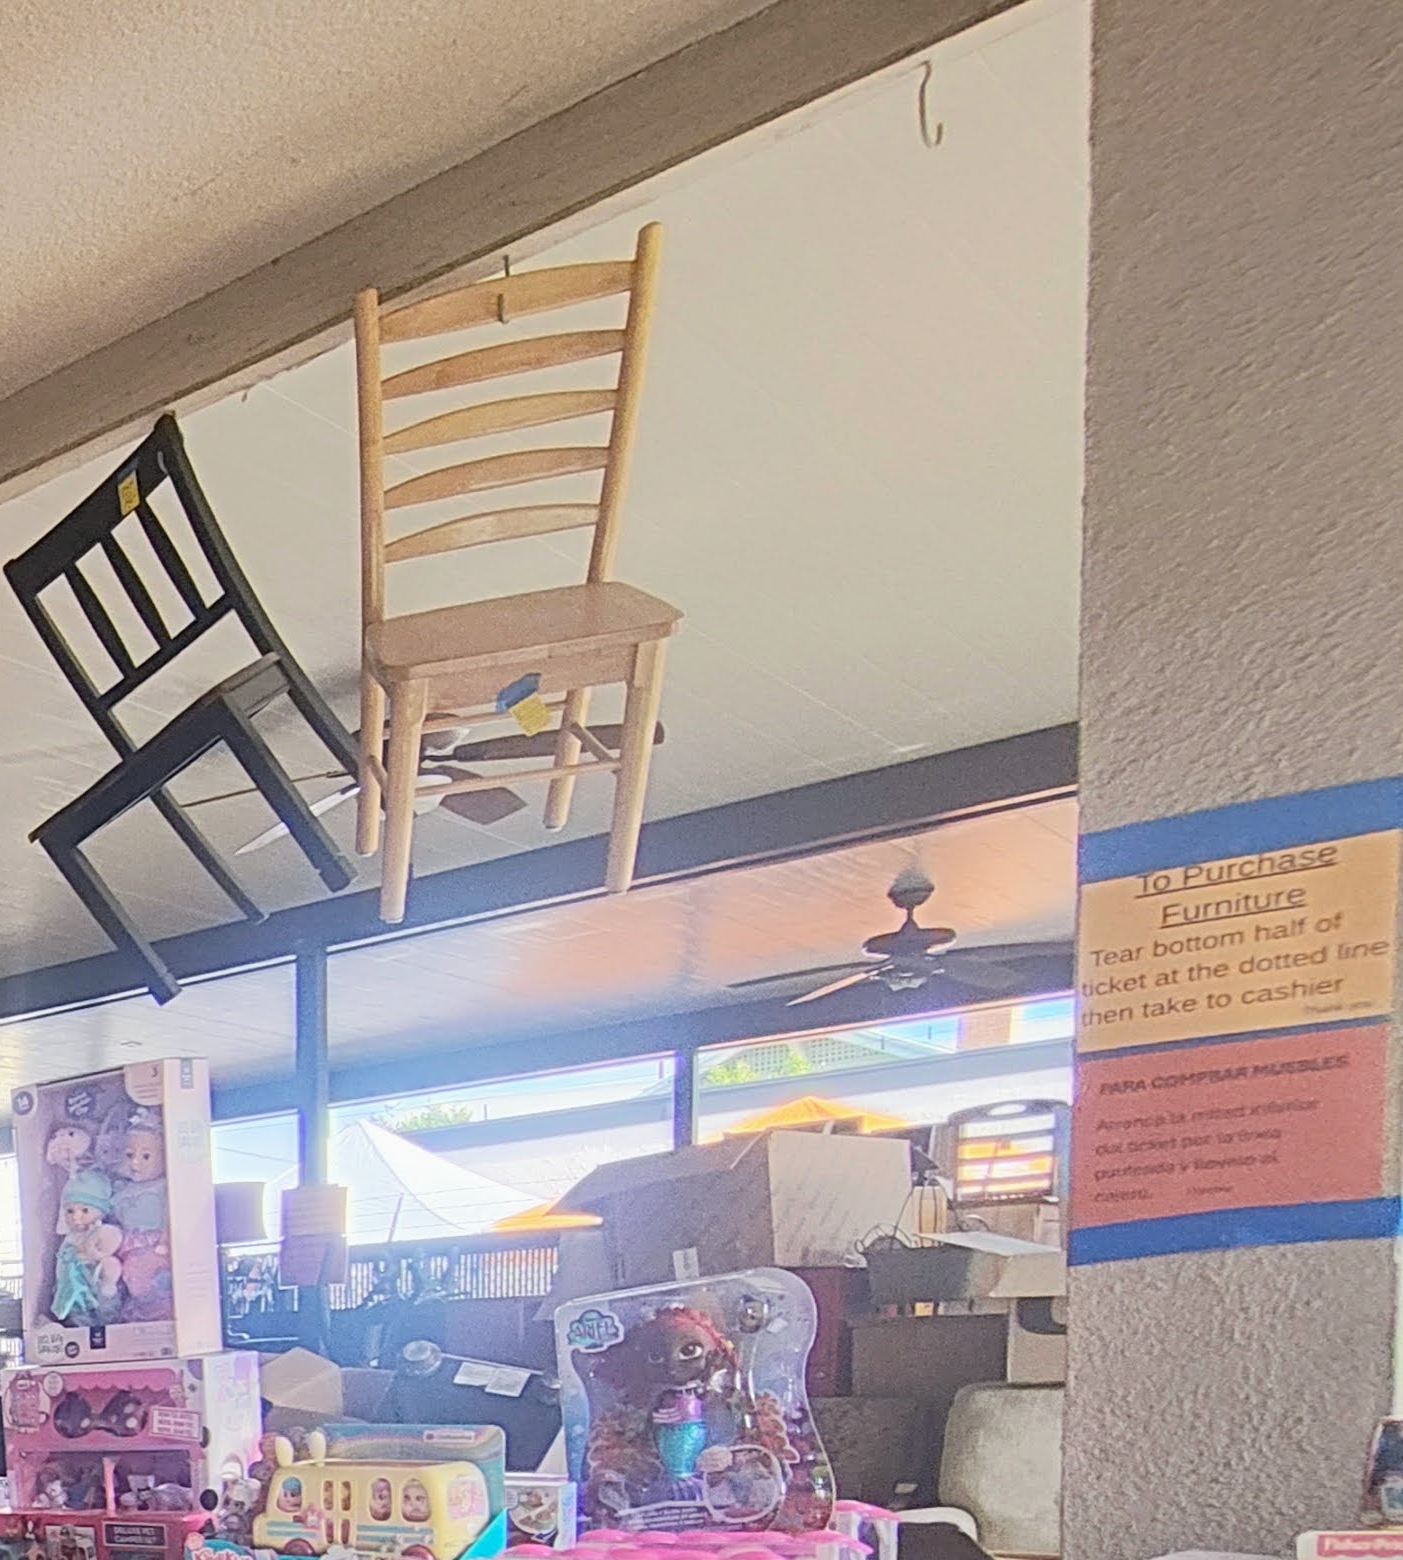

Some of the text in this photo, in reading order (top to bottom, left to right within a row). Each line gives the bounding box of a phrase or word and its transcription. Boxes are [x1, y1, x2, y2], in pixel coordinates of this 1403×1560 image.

[1137, 846, 1338, 893] To Purchase
[1161, 887, 1307, 924] Furniture
[1091, 911, 1345, 967] Tear bottom half of
[1081, 940, 1391, 998] ticket at the dotted line
[1080, 975, 1345, 1028] then take to cashier
[1099, 1074, 1148, 1096] PARA
